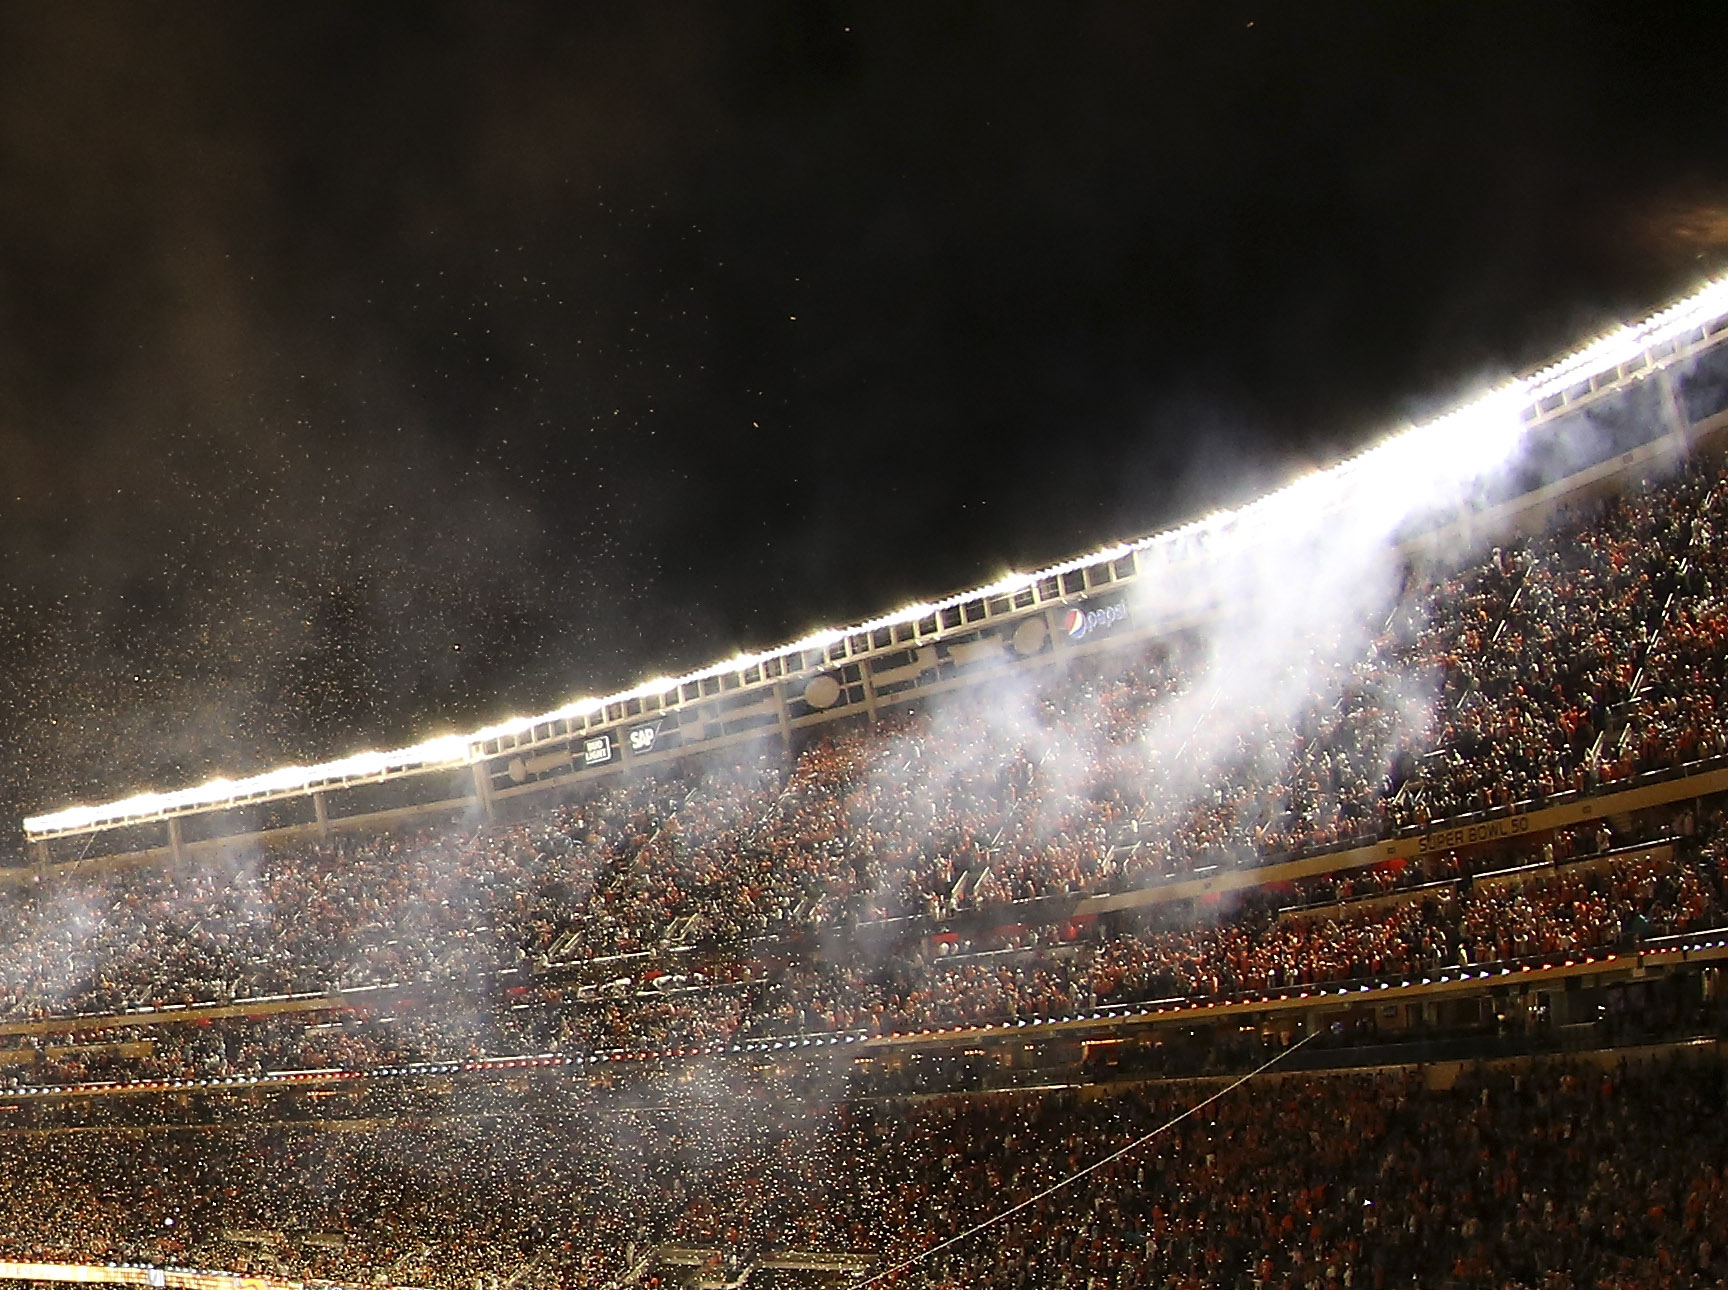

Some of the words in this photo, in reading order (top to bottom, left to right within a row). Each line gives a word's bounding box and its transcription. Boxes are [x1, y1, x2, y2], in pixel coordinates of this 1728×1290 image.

[1087, 602, 1126, 632] pepsi
[586, 740, 604, 752] BUD
[630, 728, 654, 749] SAP
[585, 747, 607, 761] LIGHT
[1418, 831, 1464, 852] SUPER
[1469, 823, 1508, 842] BOWL
[1511, 816, 1529, 832] 50
